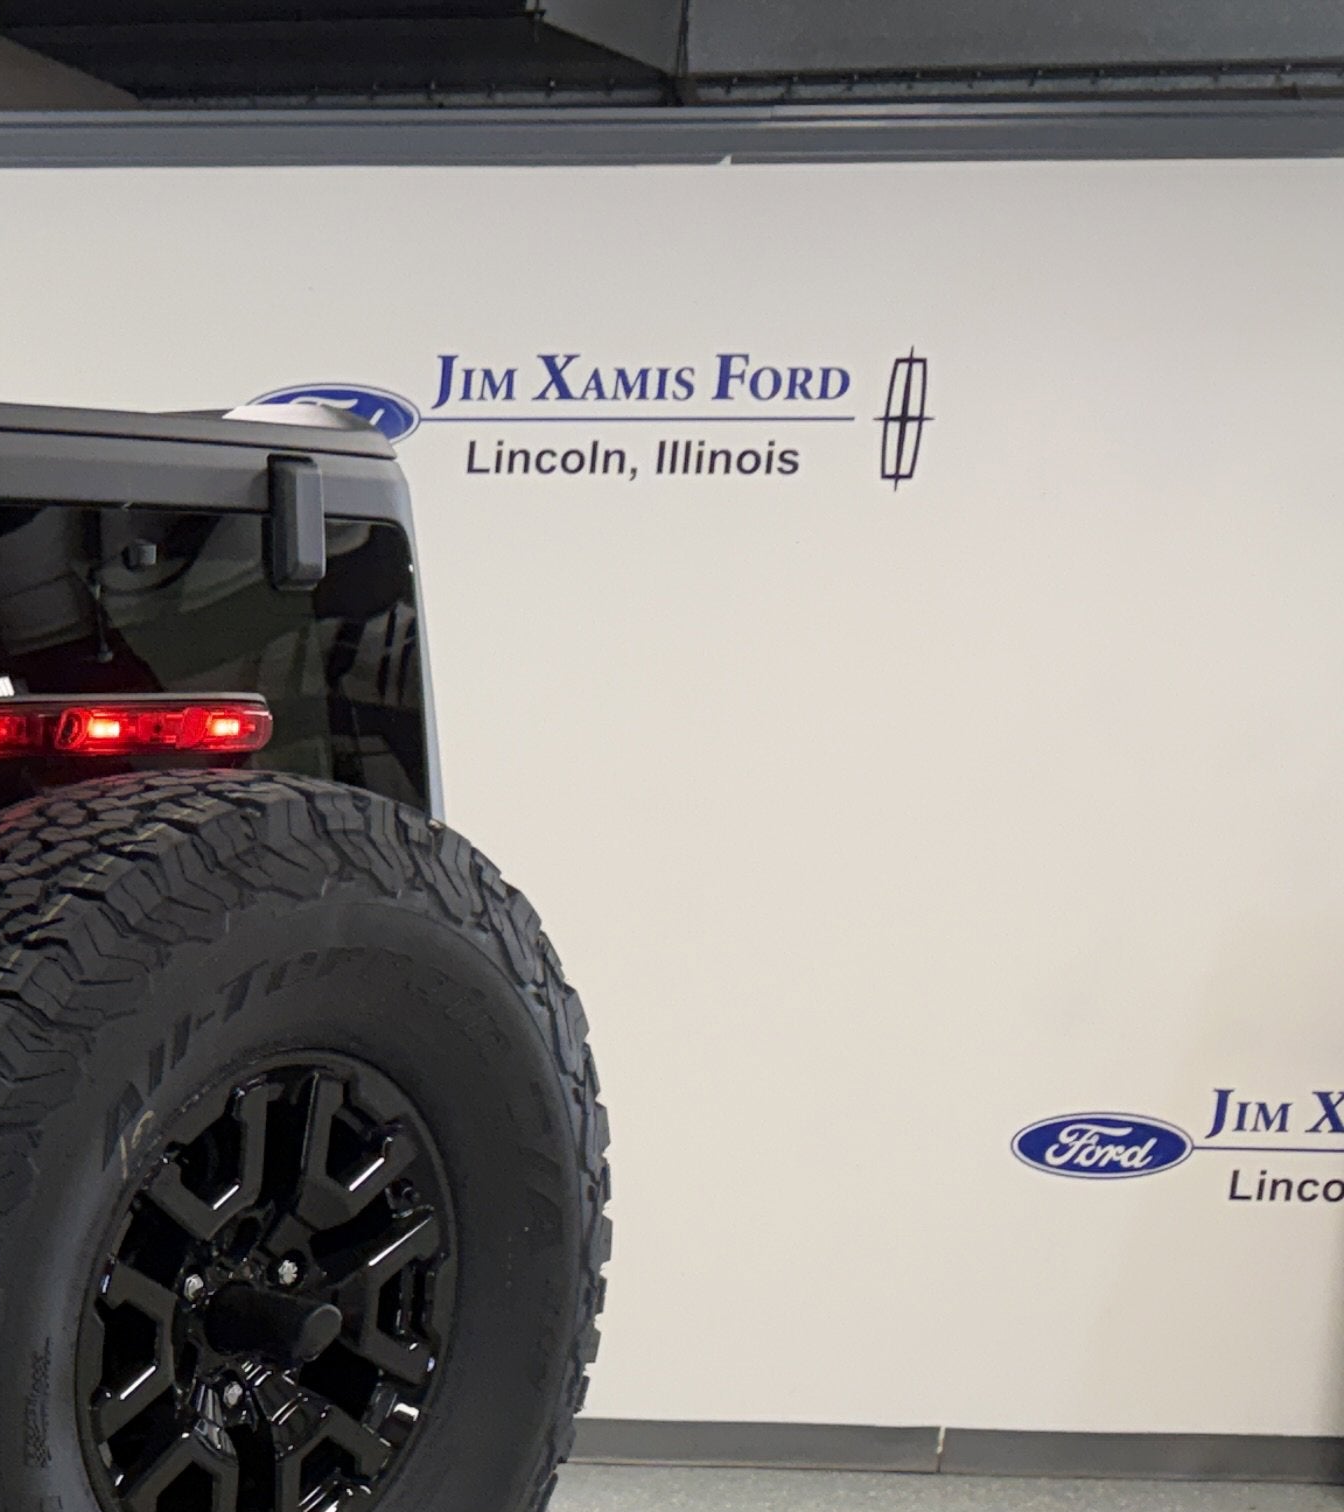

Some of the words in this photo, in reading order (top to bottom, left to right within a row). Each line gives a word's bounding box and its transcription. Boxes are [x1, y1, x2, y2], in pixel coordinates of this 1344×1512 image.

[432, 354, 518, 409] JIM
[532, 354, 696, 401] XAMIS
[713, 354, 851, 401] FORD
[467, 439, 638, 481] Lincoln,
[655, 439, 800, 476] Illinois
[1204, 1087, 1293, 1139] JIM
[1044, 1123, 1158, 1169] Ford
